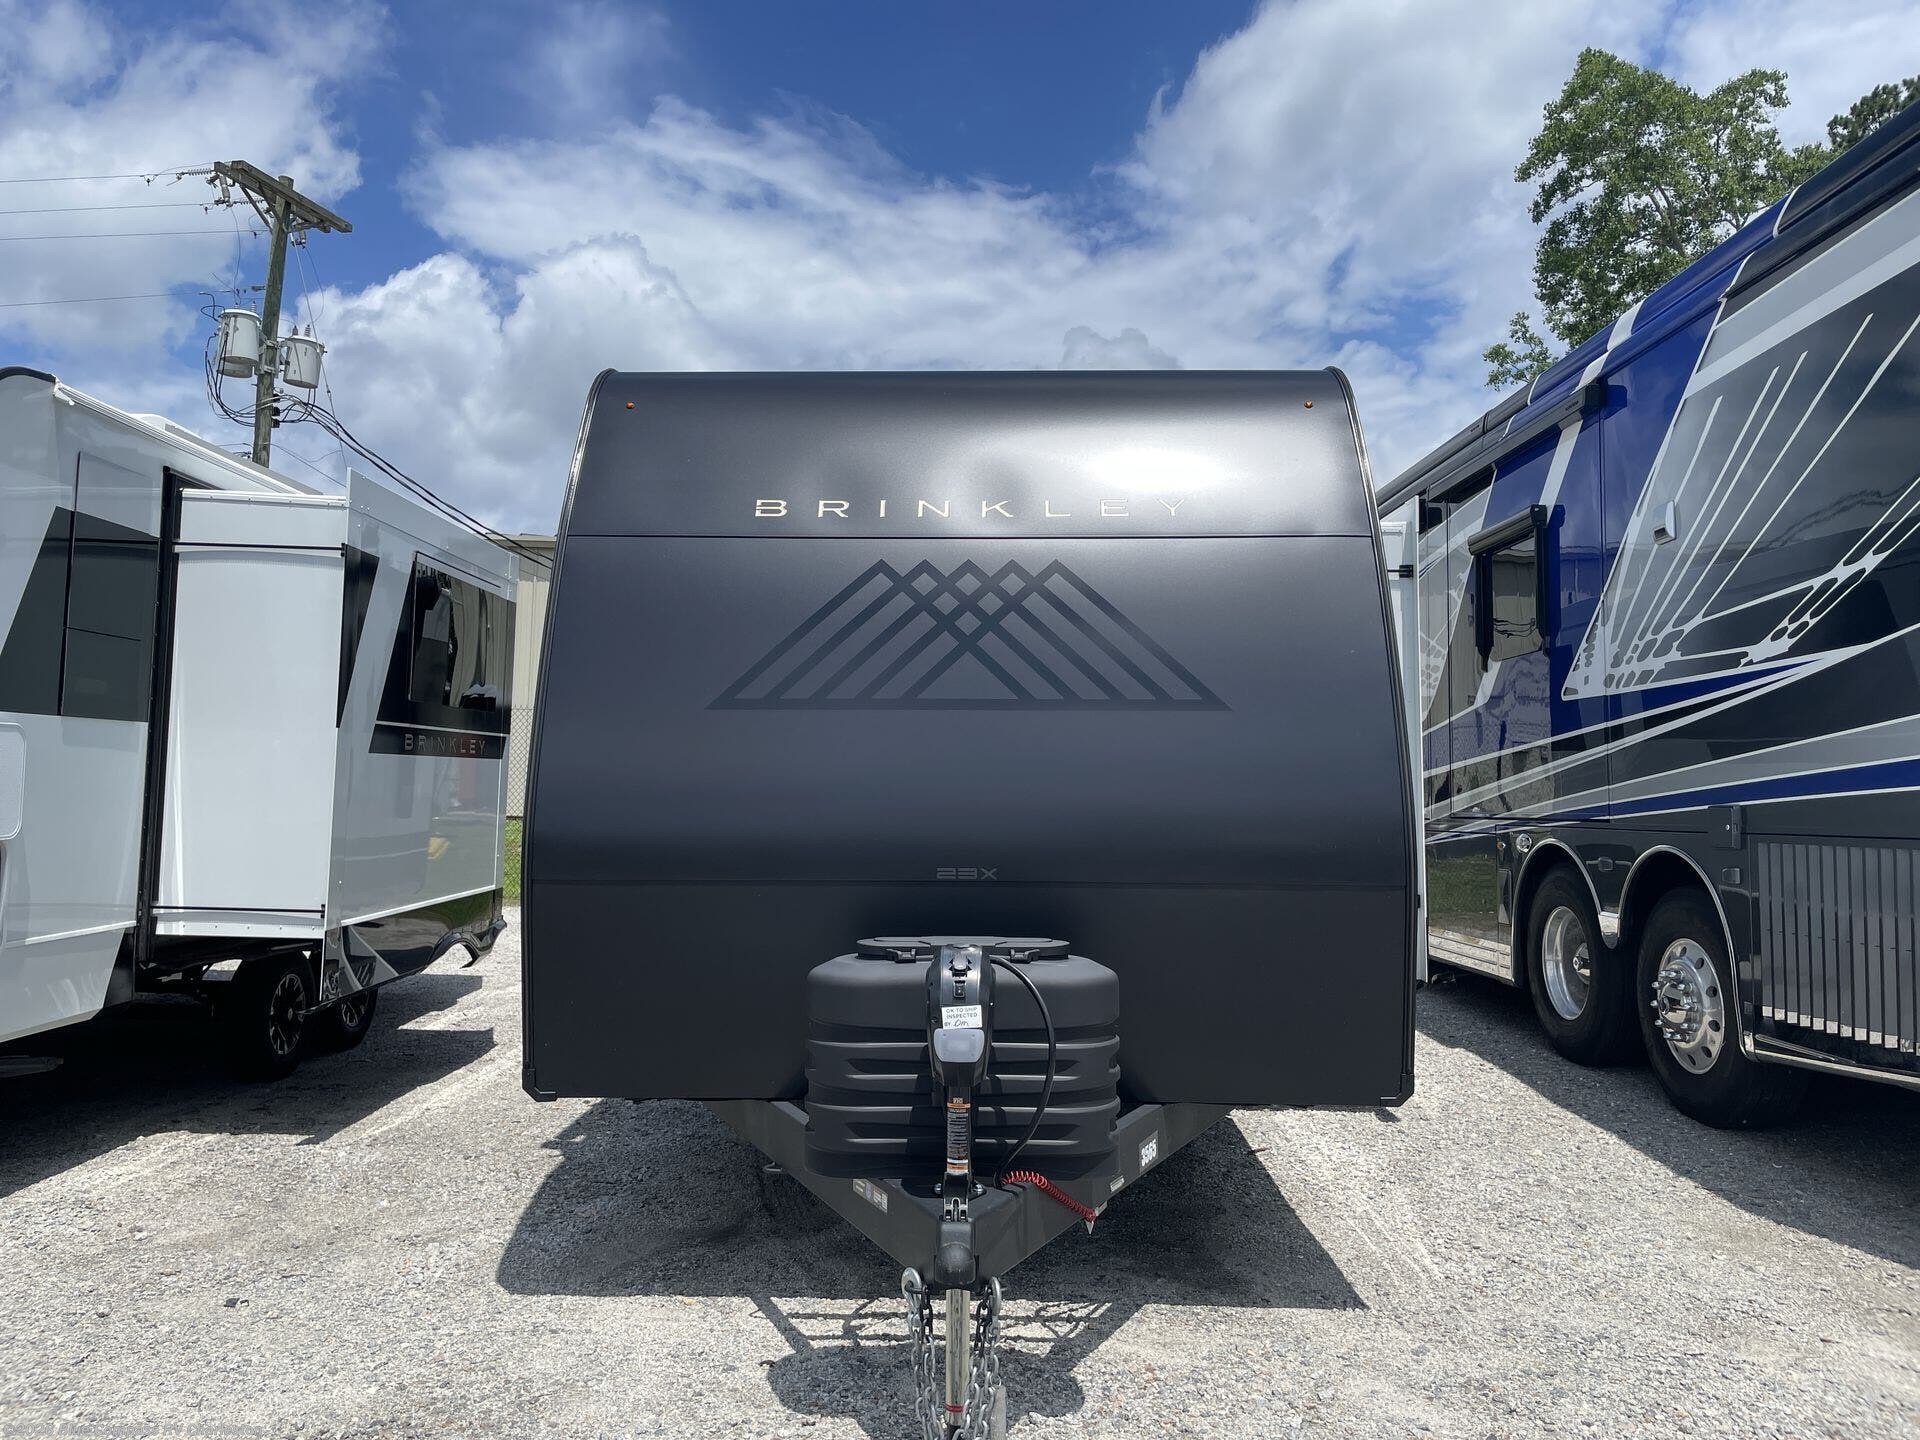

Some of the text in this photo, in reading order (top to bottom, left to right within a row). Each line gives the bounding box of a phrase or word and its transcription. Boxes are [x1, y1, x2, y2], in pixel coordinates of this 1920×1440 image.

[754, 498, 1186, 519] BRINKLEY
[404, 734, 486, 754] BRINKLEY
[936, 867, 998, 880] 23X
